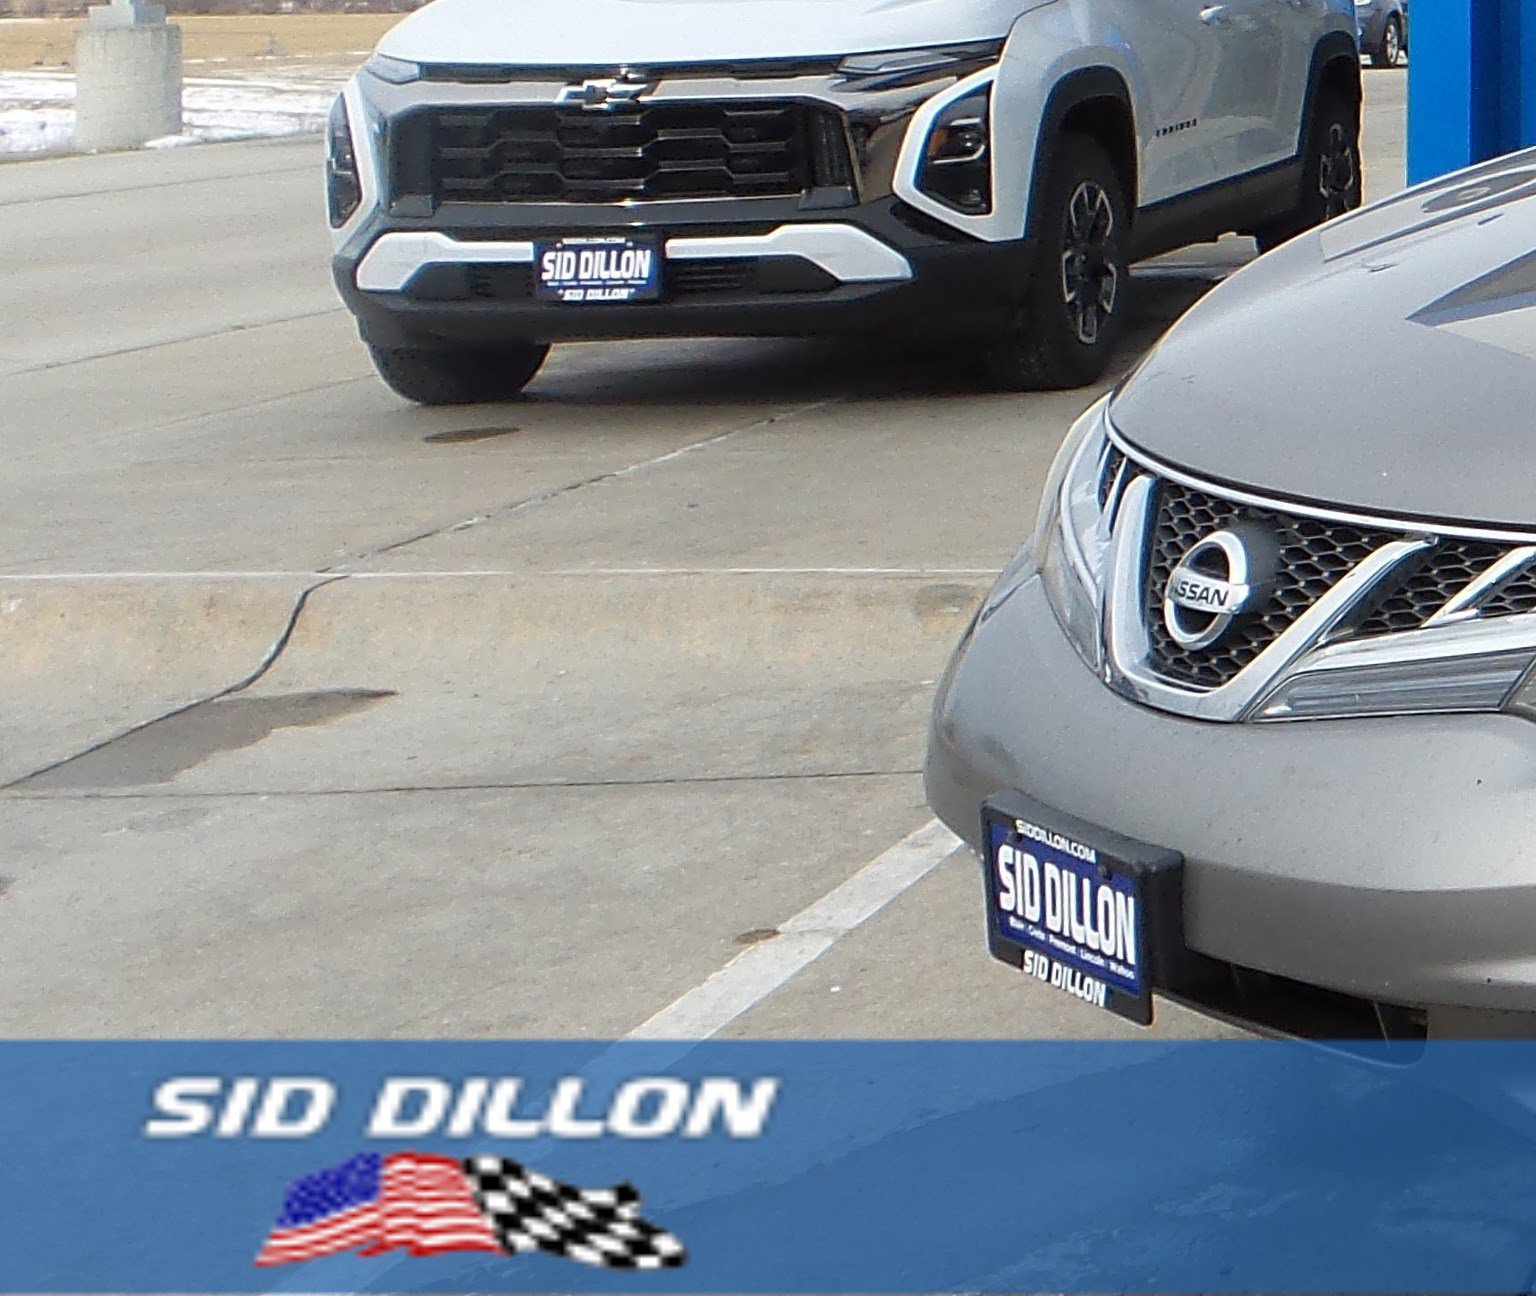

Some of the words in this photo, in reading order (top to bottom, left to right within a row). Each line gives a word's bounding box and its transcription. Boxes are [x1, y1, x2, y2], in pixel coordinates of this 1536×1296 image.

[541, 250, 576, 281] SID
[578, 249, 651, 280] DILLON
[1170, 579, 1230, 607] SSAN
[1015, 819, 1097, 864] SIDDILLON.COM
[998, 844, 1041, 923] SID
[1044, 862, 1136, 965] DILLON
[1023, 950, 1048, 982] SID
[1051, 964, 1107, 1008] DILLON
